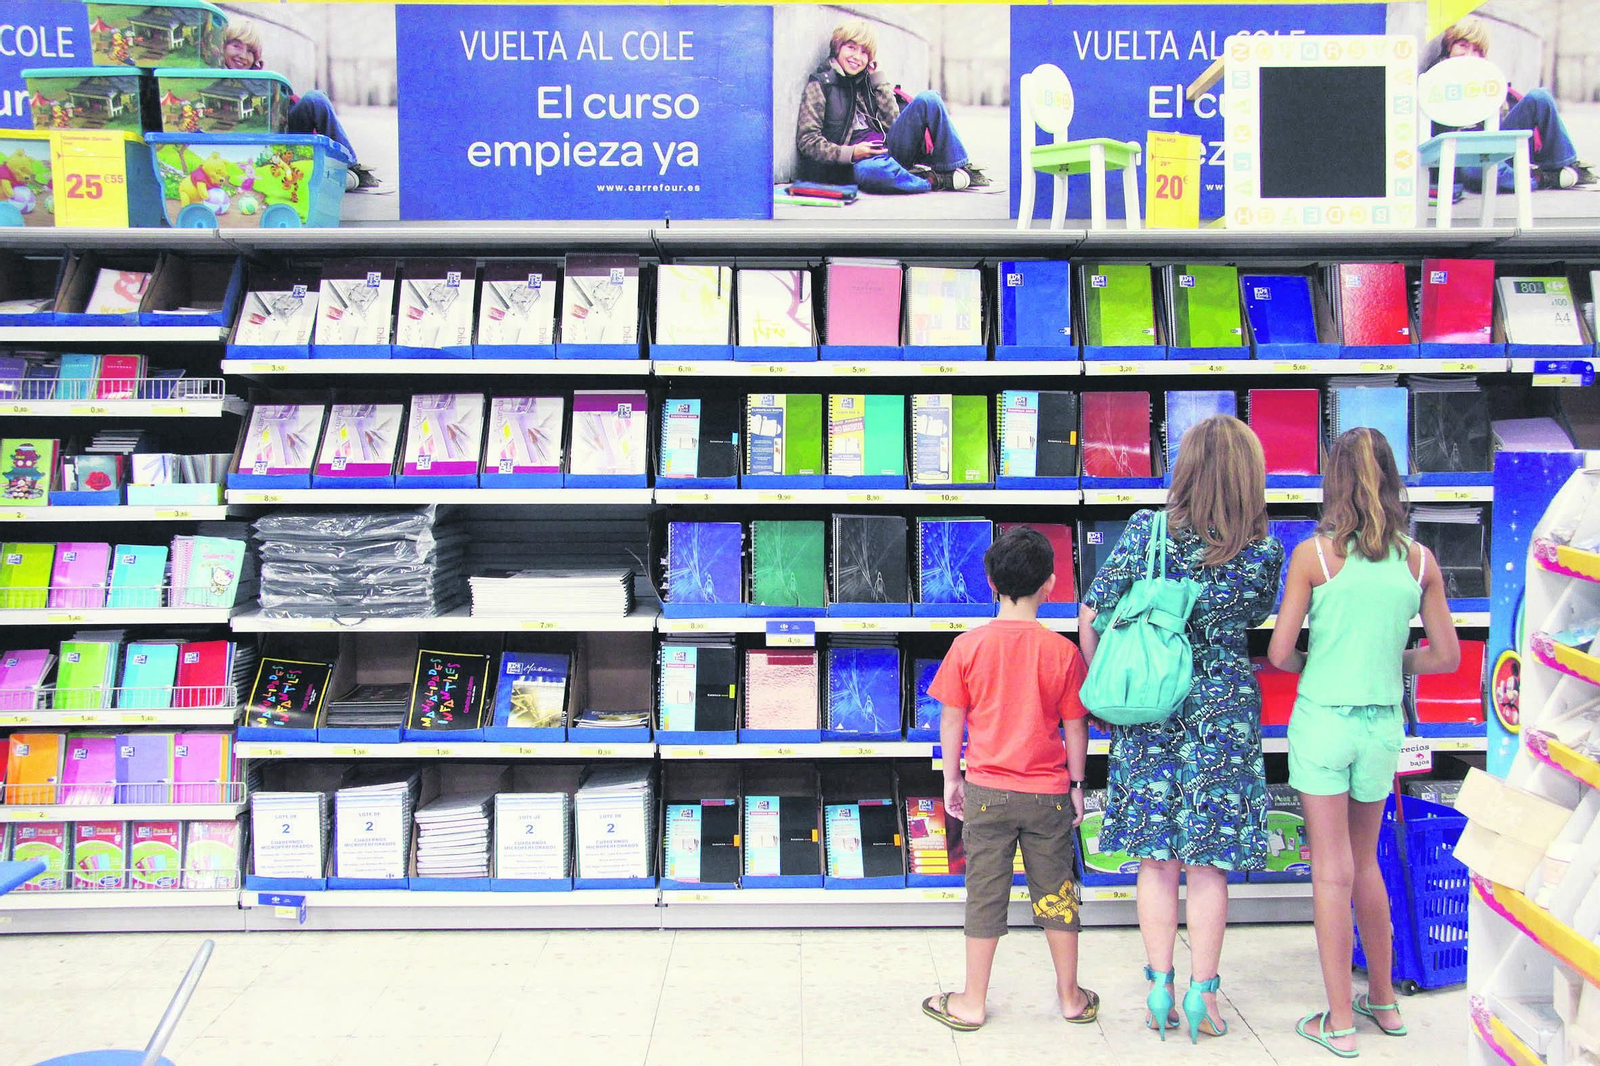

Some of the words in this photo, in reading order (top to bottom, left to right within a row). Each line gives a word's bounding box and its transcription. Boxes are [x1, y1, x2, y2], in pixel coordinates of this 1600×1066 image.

[460, 30, 568, 61] VUELTA
[577, 30, 614, 61] AL
[622, 30, 695, 61] COLE
[1072, 30, 1181, 61] VUELTA
[1188, 30, 1225, 61] AL
[537, 84, 573, 119] El
[583, 93, 700, 119] curso
[1149, 84, 1183, 119] El
[467, 131, 643, 176] empieza
[652, 141, 699, 176] ya
[65, 173, 103, 200] 25
[596, 183, 701, 192] www.carrefour.es
[1156, 174, 1183, 200] 20
[1520, 282, 1537, 293] 80
[1399, 743, 1430, 753] recios
[1409, 759, 1430, 768] bajos
[282, 823, 290, 834] 2
[365, 821, 374, 832] 2
[525, 824, 534, 835] 2
[607, 823, 616, 834] 2
